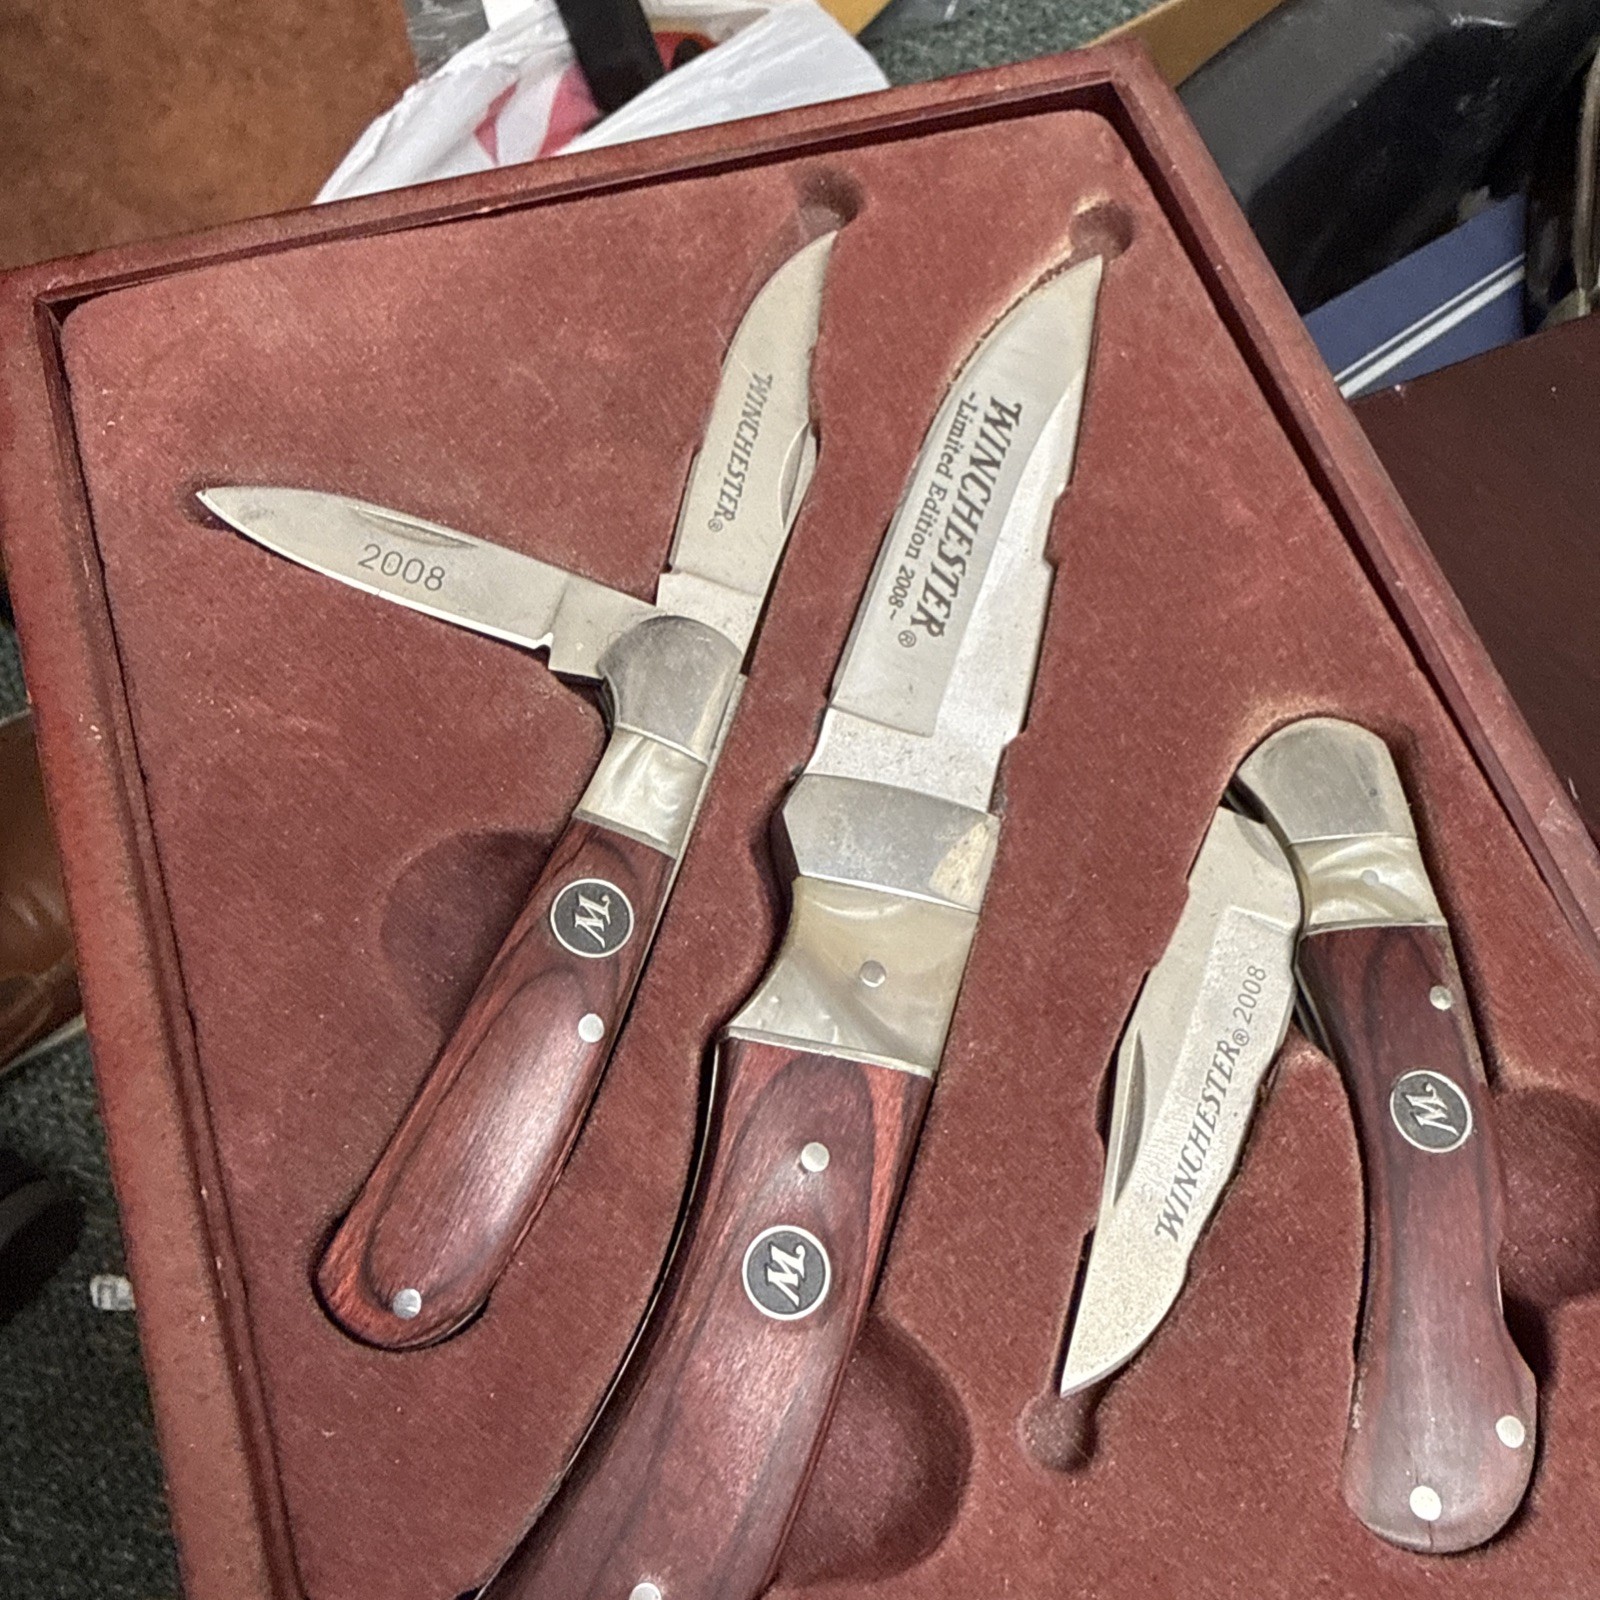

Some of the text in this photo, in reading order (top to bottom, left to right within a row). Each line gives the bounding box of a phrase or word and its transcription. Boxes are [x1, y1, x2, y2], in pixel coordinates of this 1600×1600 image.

[904, 480, 948, 560] Edition
[357, 543, 446, 591] 2008
[1232, 964, 1267, 1026] 2008
